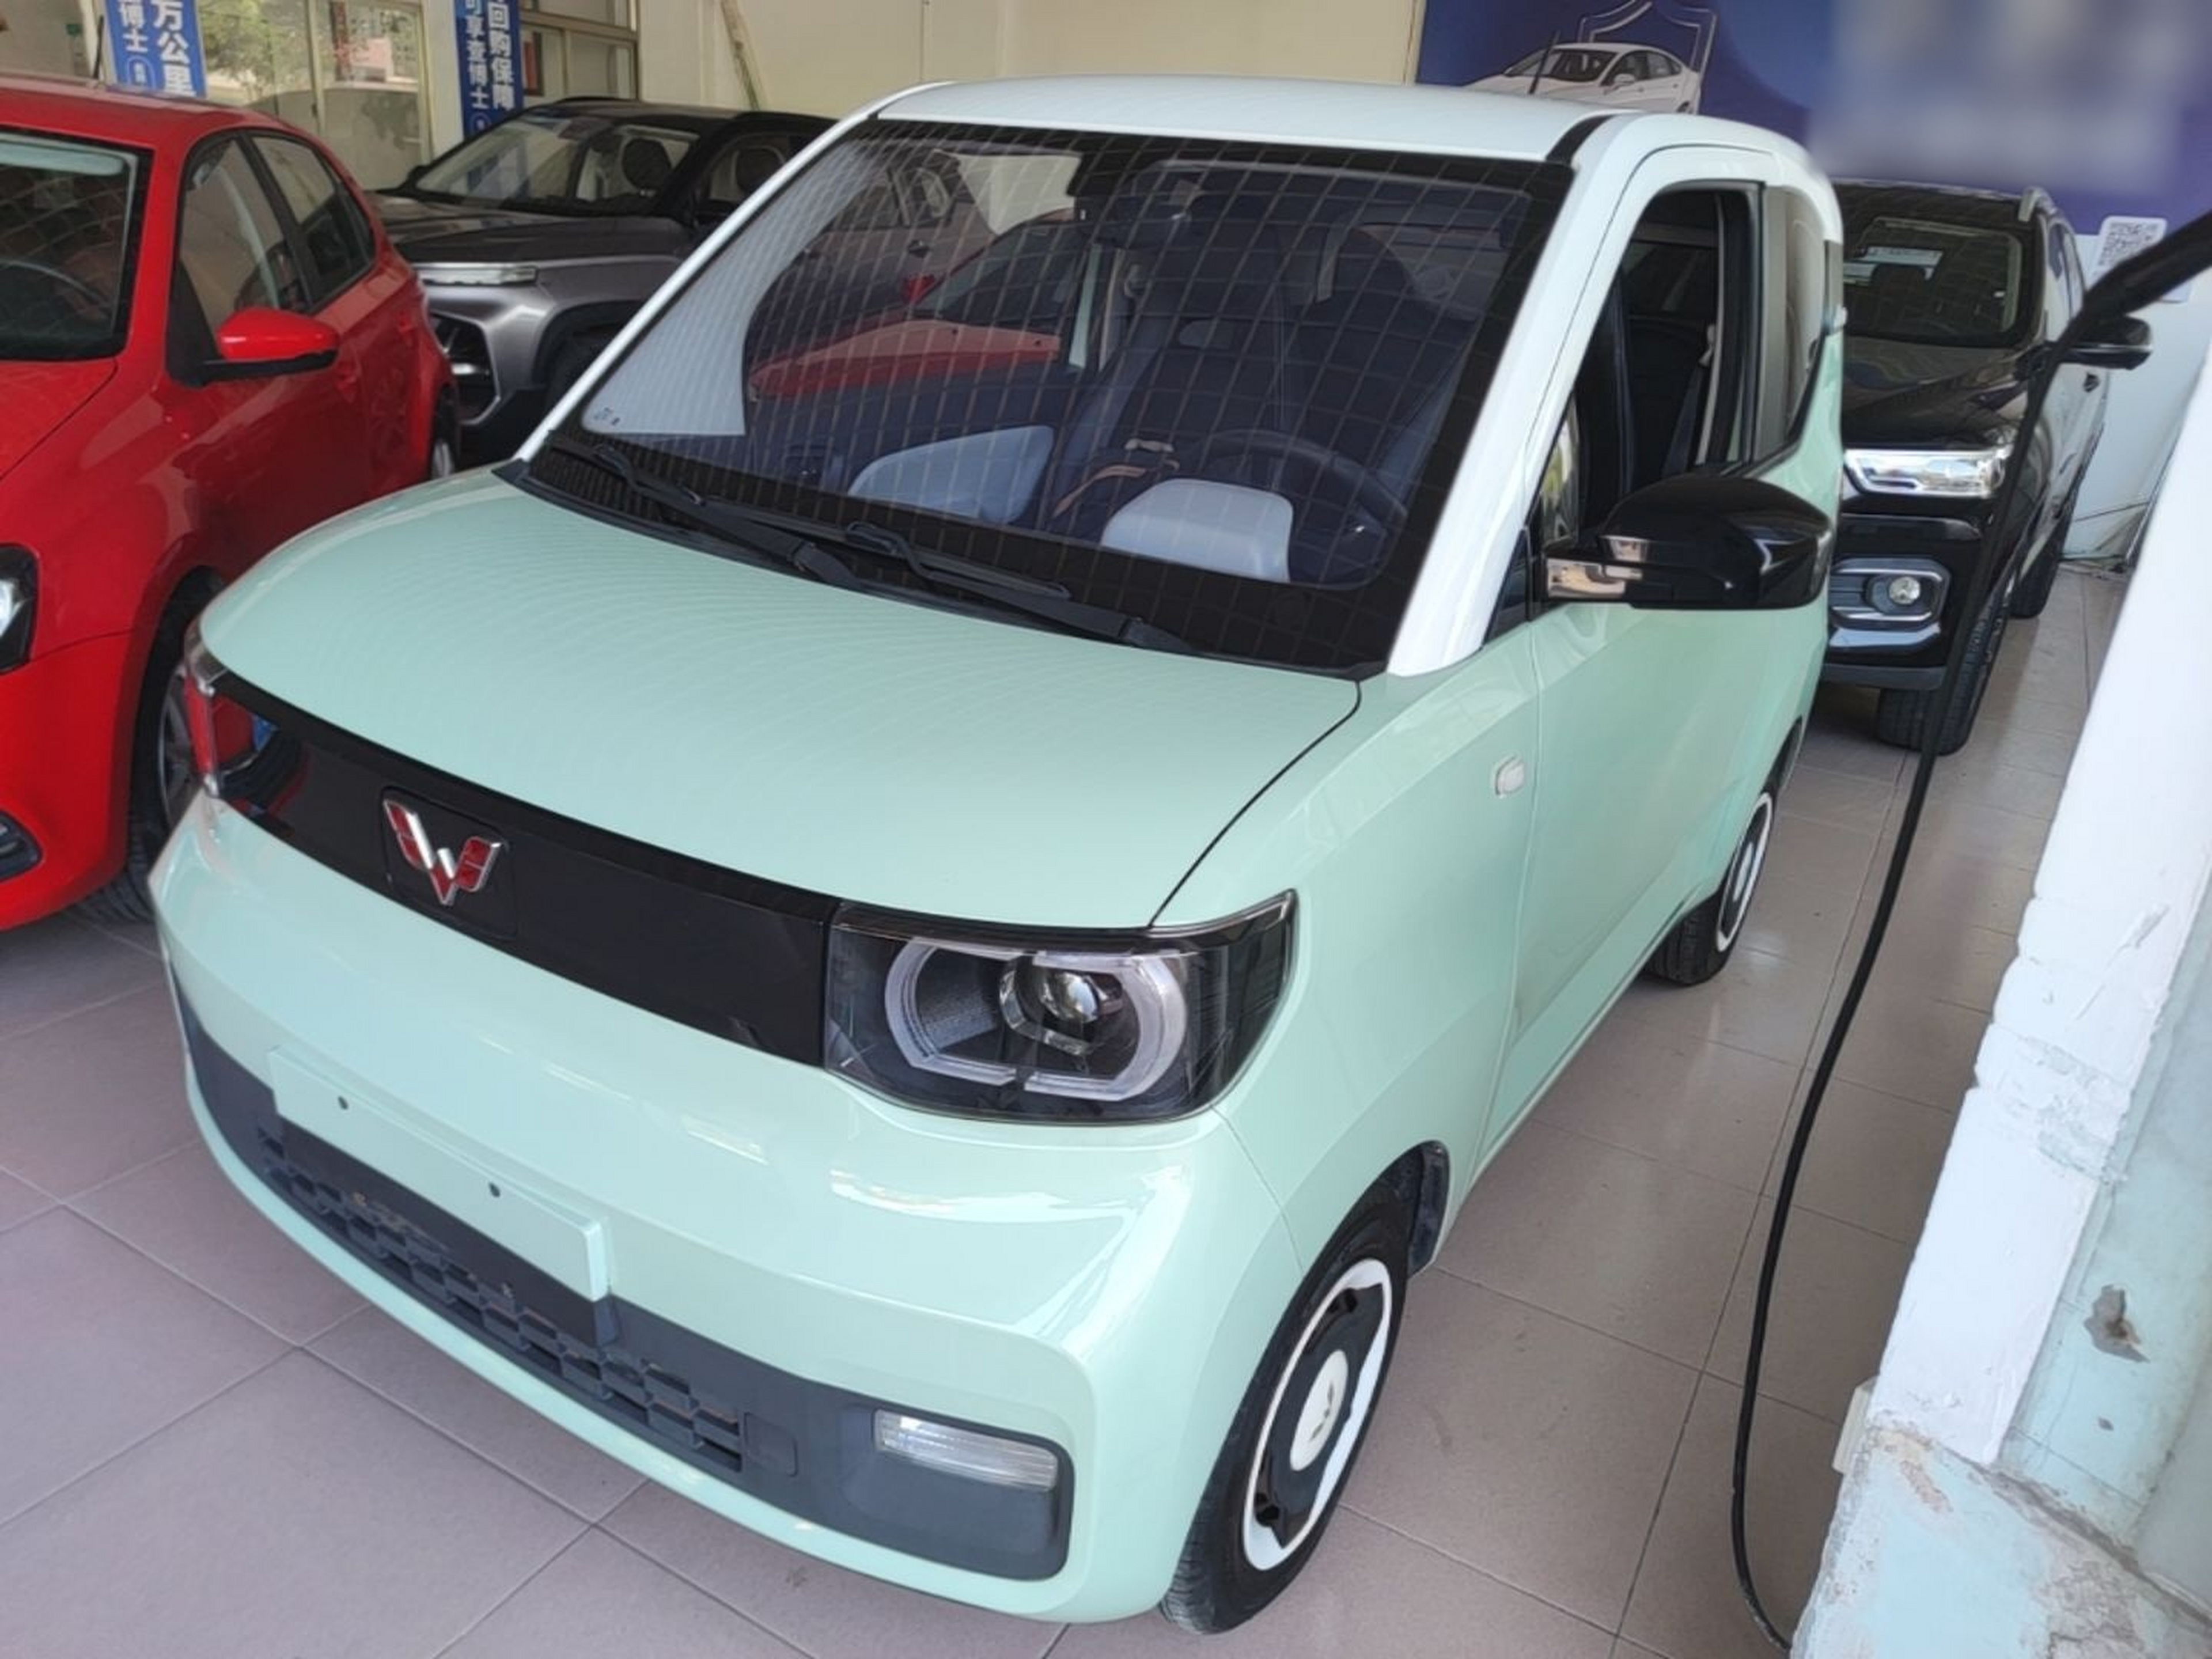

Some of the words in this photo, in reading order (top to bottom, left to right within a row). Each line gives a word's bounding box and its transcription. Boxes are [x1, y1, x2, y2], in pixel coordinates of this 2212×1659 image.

[118, 0, 148, 53] 博士
[151, 0, 197, 97] 万公里
[488, 0, 515, 111] 回购保障
